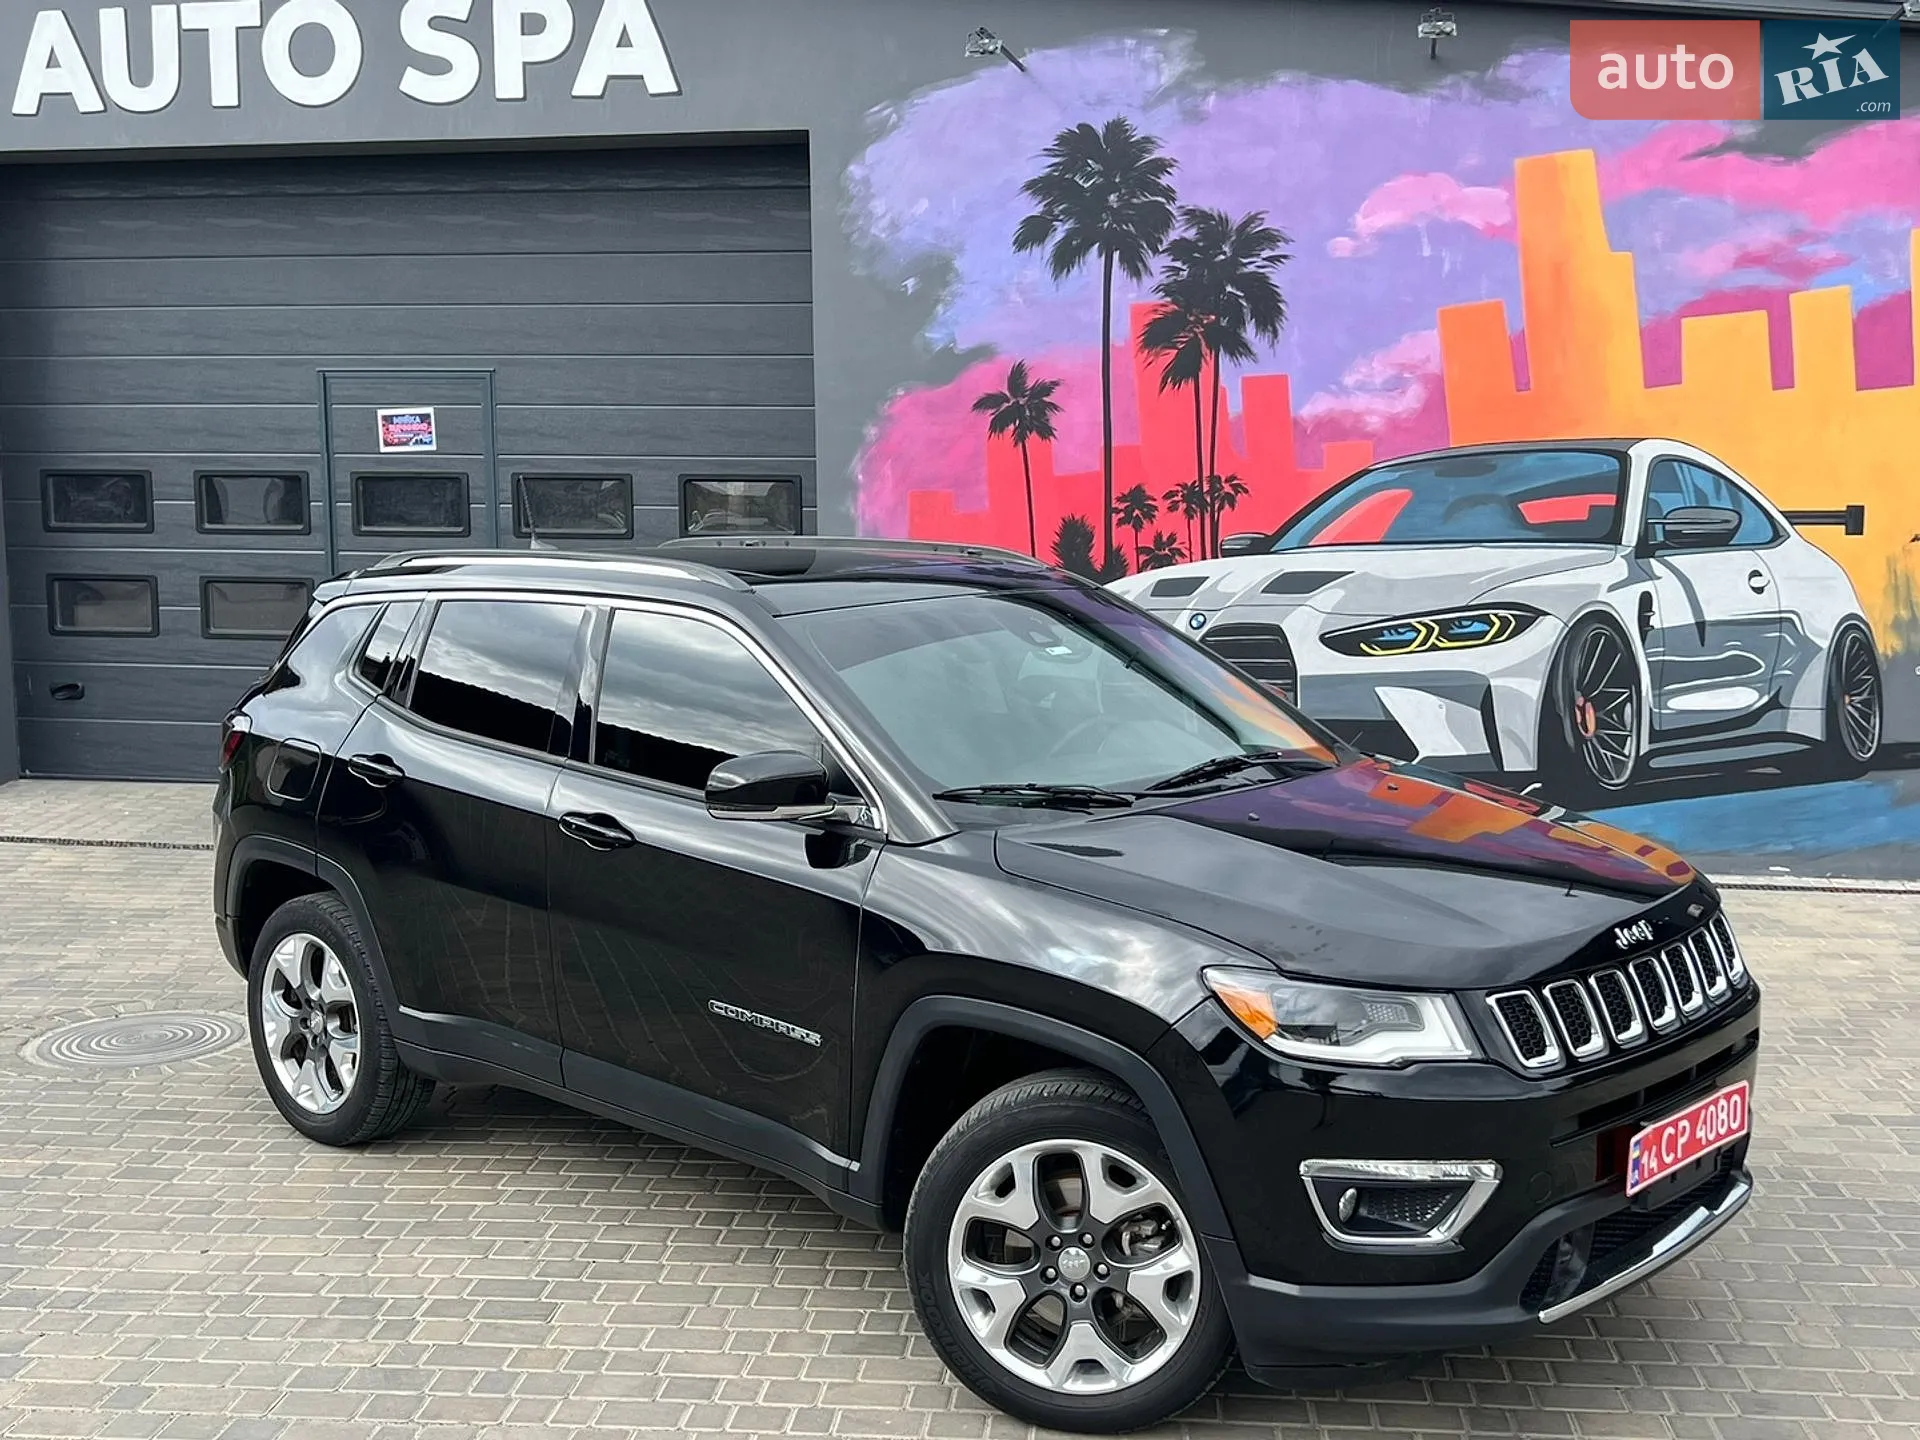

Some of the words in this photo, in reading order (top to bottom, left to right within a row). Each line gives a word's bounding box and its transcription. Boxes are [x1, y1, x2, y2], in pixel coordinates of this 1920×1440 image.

[11, 0, 363, 116] AUTO
[398, 0, 683, 107] SPA
[1613, 919, 1654, 950] Jeep
[707, 999, 823, 1047] COMPASS
[1640, 1144, 1659, 1179] 14
[1661, 1118, 1691, 1165] CP
[1695, 1093, 1742, 1146] 4080
